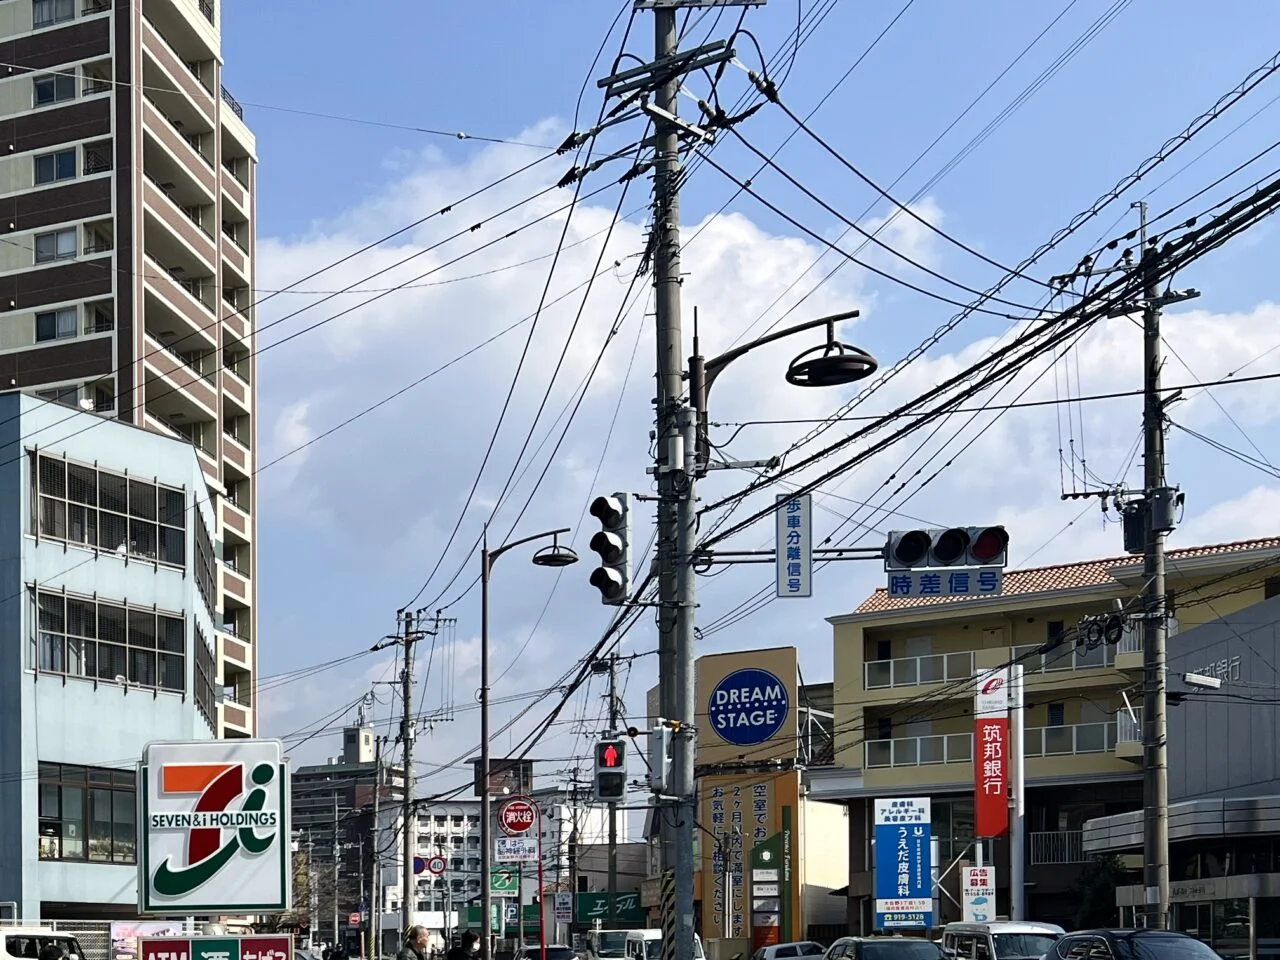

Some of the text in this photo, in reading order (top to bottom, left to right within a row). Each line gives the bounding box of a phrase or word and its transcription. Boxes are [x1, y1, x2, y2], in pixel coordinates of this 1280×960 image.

[786, 499, 801, 593] 歩車分離信号
[890, 570, 1000, 596] 時差信号
[716, 685, 782, 706] DREAM
[717, 710, 776, 730] STAGE
[982, 724, 1002, 796] 筑邦銀行
[151, 812, 276, 828] SEVEN&i HOLDINGS
[506, 810, 532, 824] 消火栓
[753, 784, 767, 848] 空室でお
[880, 807, 925, 815] アレルギー科
[431, 861, 443, 870] 40
[897, 826, 910, 897] うえだ皮膚科
[970, 868, 988, 877] 広告
[970, 878, 988, 887] 募集
